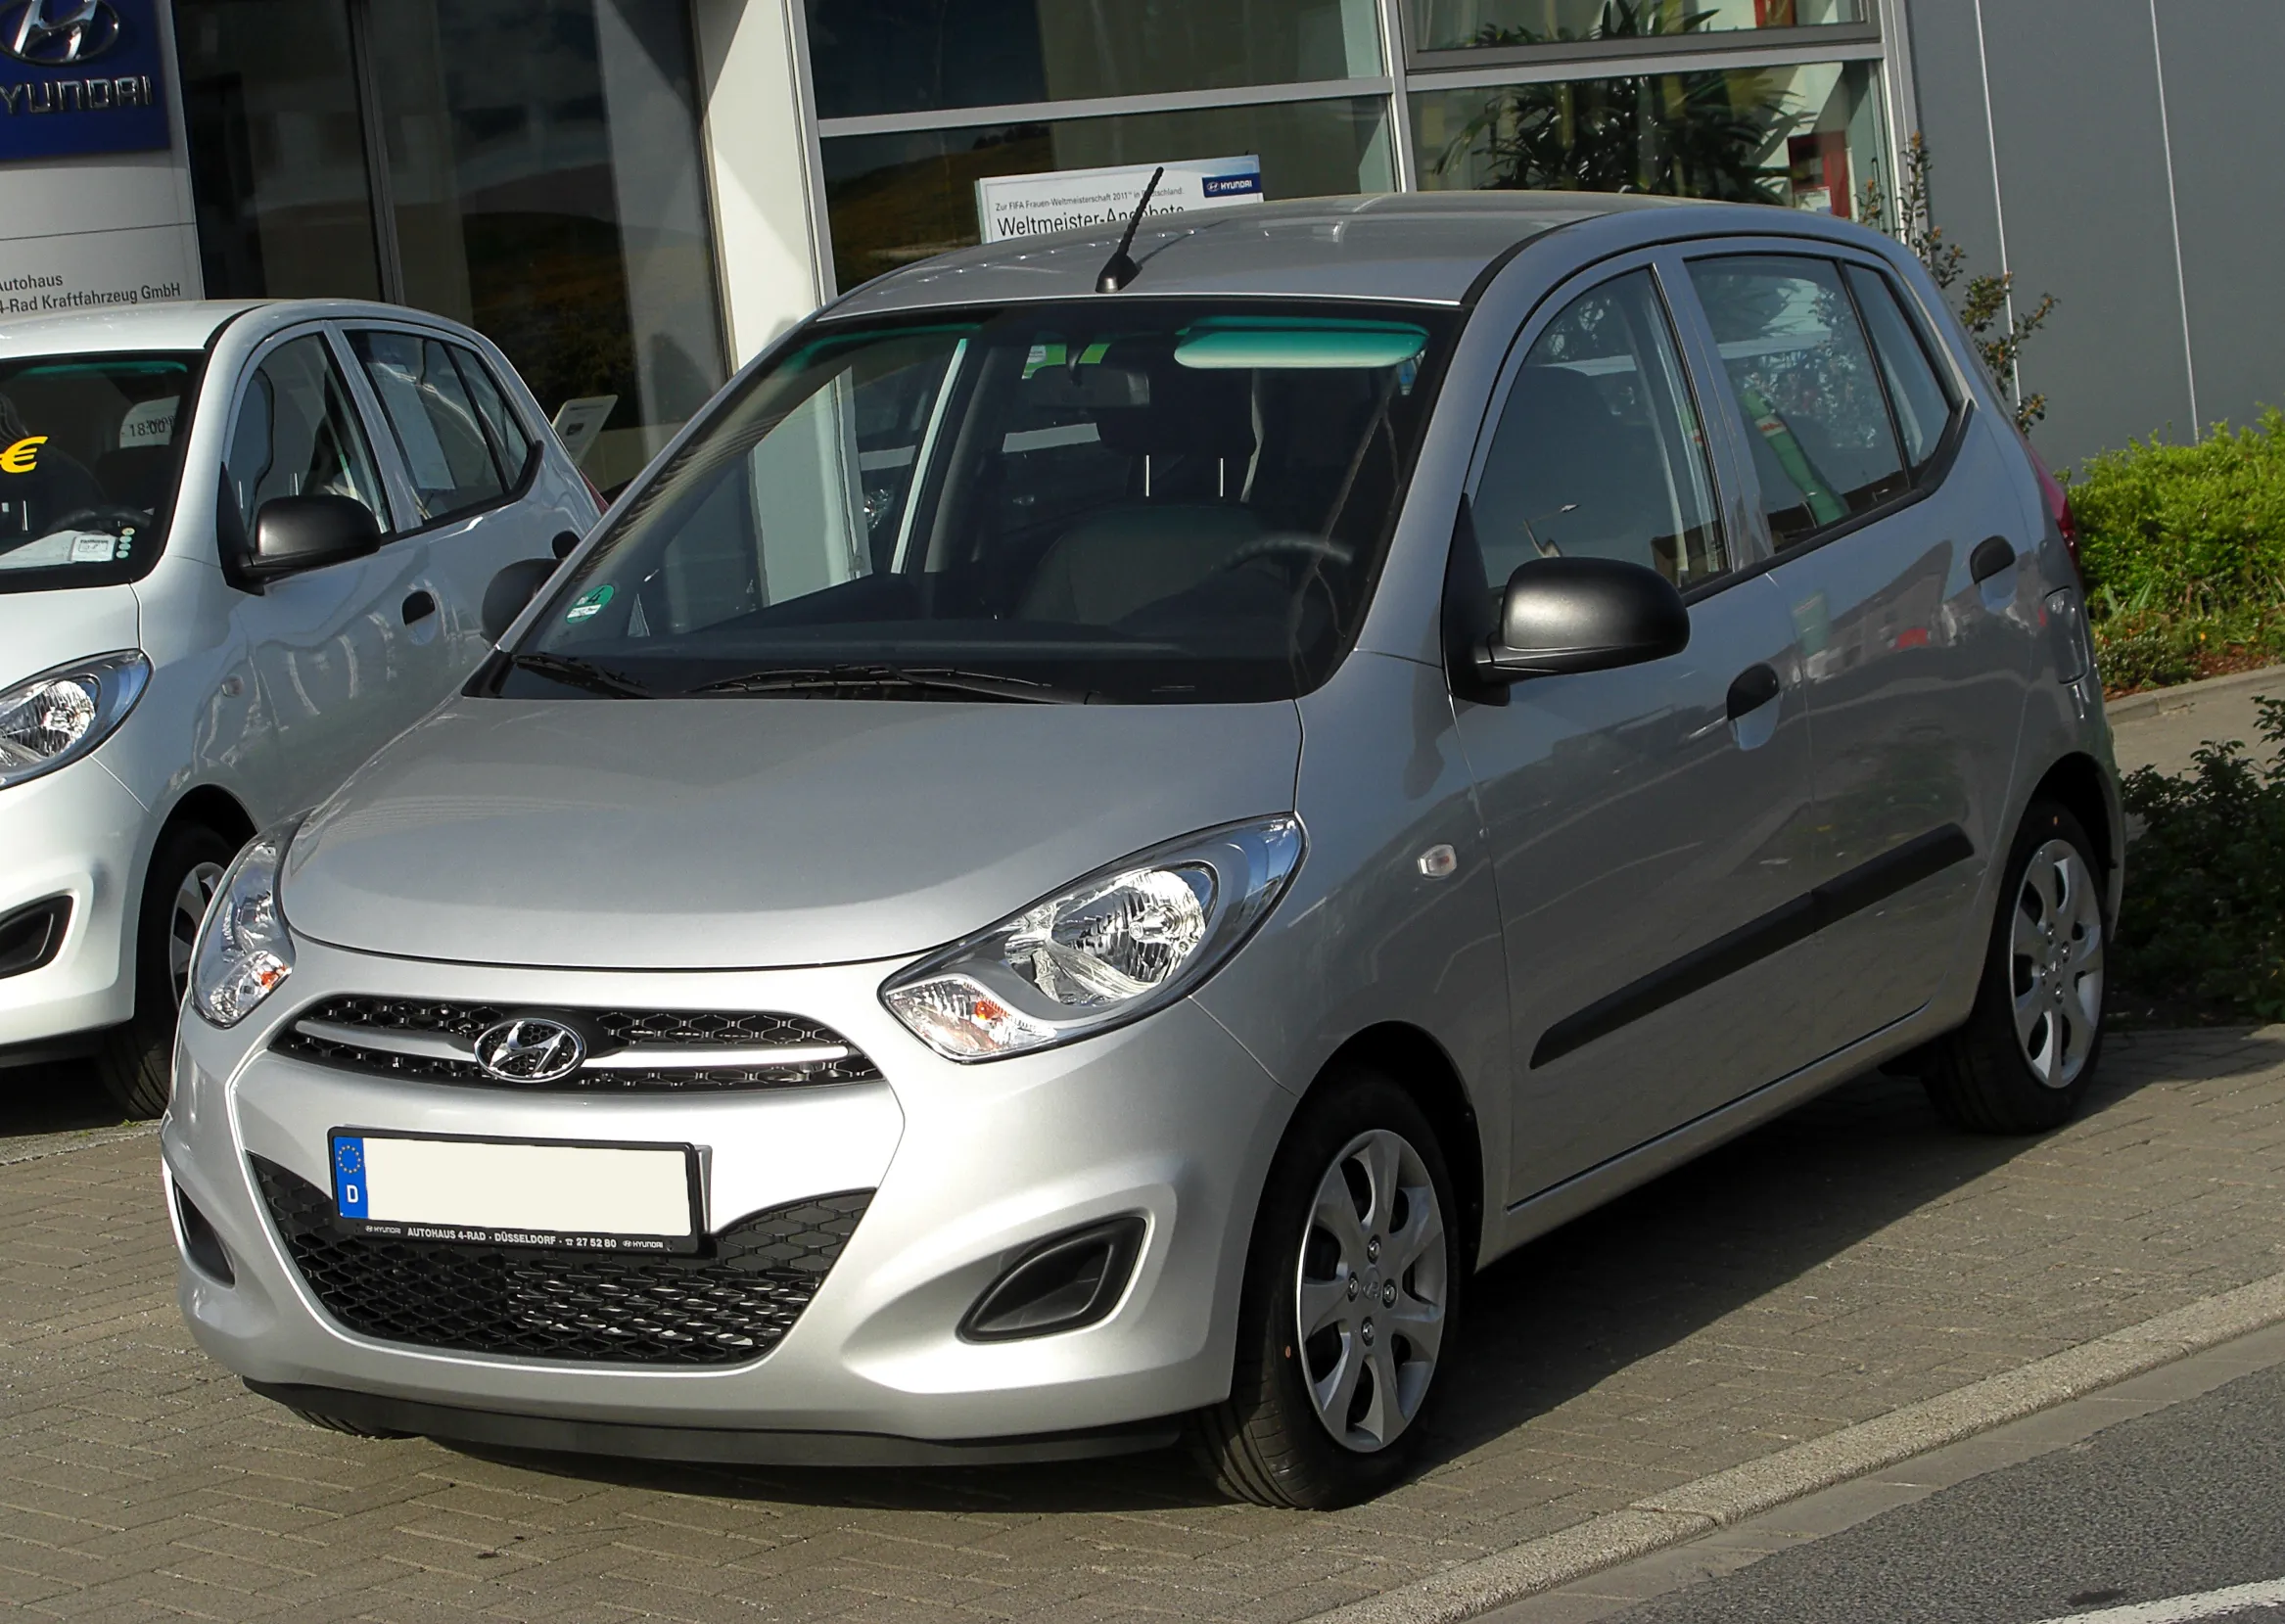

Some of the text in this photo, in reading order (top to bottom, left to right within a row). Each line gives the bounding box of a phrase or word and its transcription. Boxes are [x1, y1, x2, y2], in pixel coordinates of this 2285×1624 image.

[0, 75, 152, 115] YUNDAI
[1220, 180, 1252, 190] HYUNDAI
[996, 203, 1007, 211] Zur
[1008, 201, 1024, 209] FIFA
[1026, 193, 1111, 209] Frauen-Weltmeisterschaft
[998, 204, 1185, 236] Weltmeister-Anb
[42, 290, 138, 309] Kraftfahrzeug
[141, 282, 181, 300] GmbH
[587, 586, 605, 603] 4
[347, 1184, 358, 1203] D
[407, 1228, 455, 1239] AUTOHAUS
[458, 1230, 486, 1240] 4-RAD
[494, 1230, 556, 1245] DÜSSELDORF
[576, 1237, 587, 1246] 27
[590, 1238, 602, 1247] 52
[604, 1239, 617, 1248] 80
